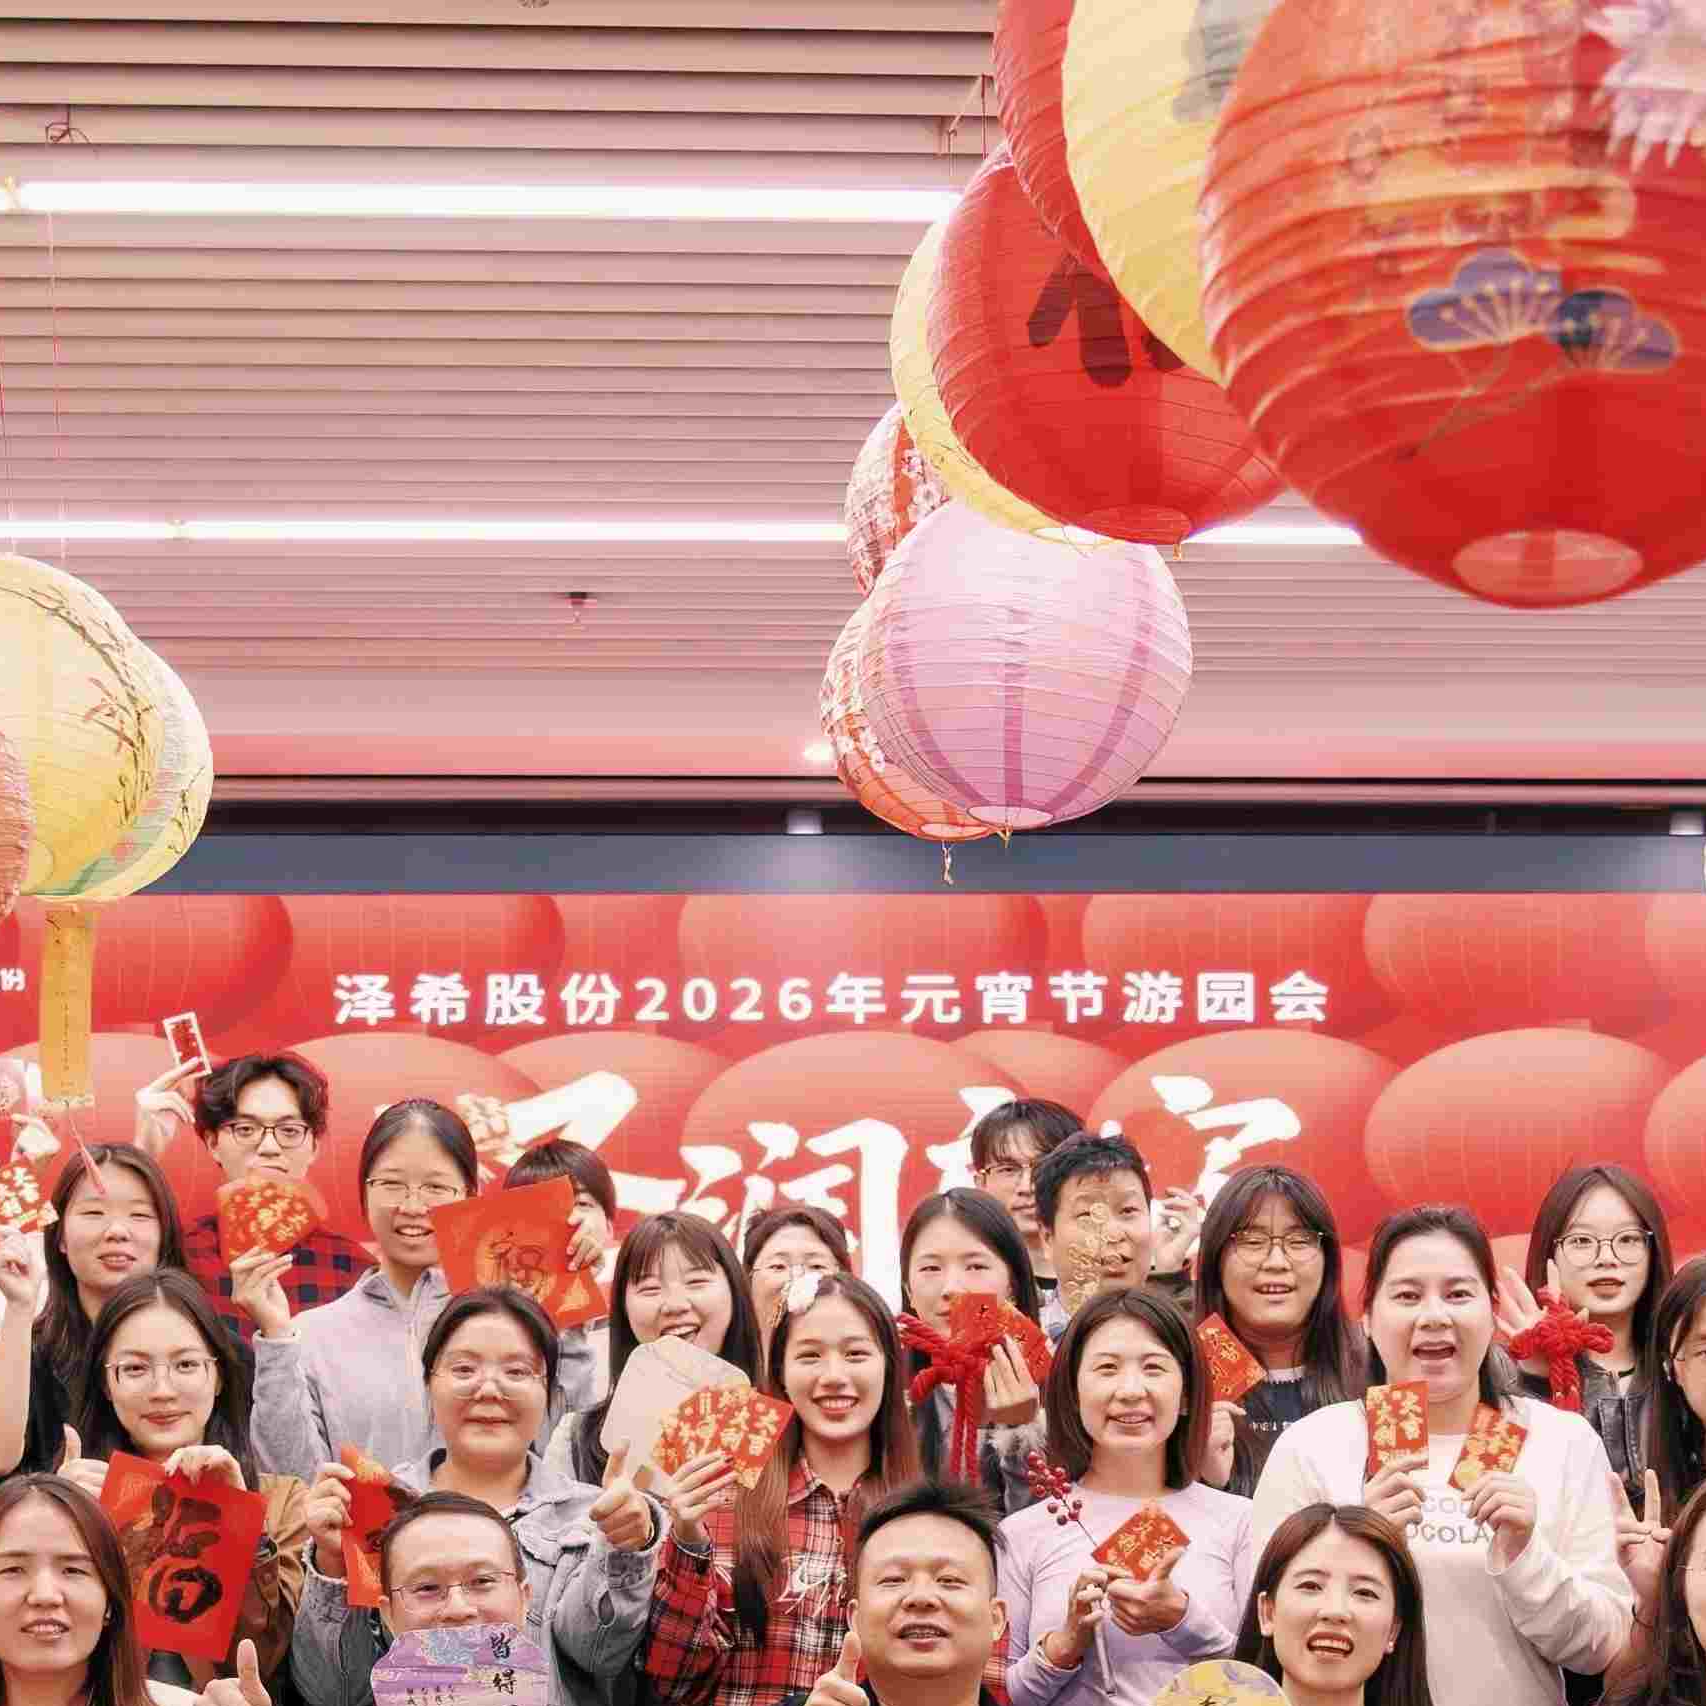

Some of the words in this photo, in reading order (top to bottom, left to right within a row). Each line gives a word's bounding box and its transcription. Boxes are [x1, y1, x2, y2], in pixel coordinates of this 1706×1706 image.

[334, 972, 1329, 1025] 泽希股份2026年元宵节游园会
